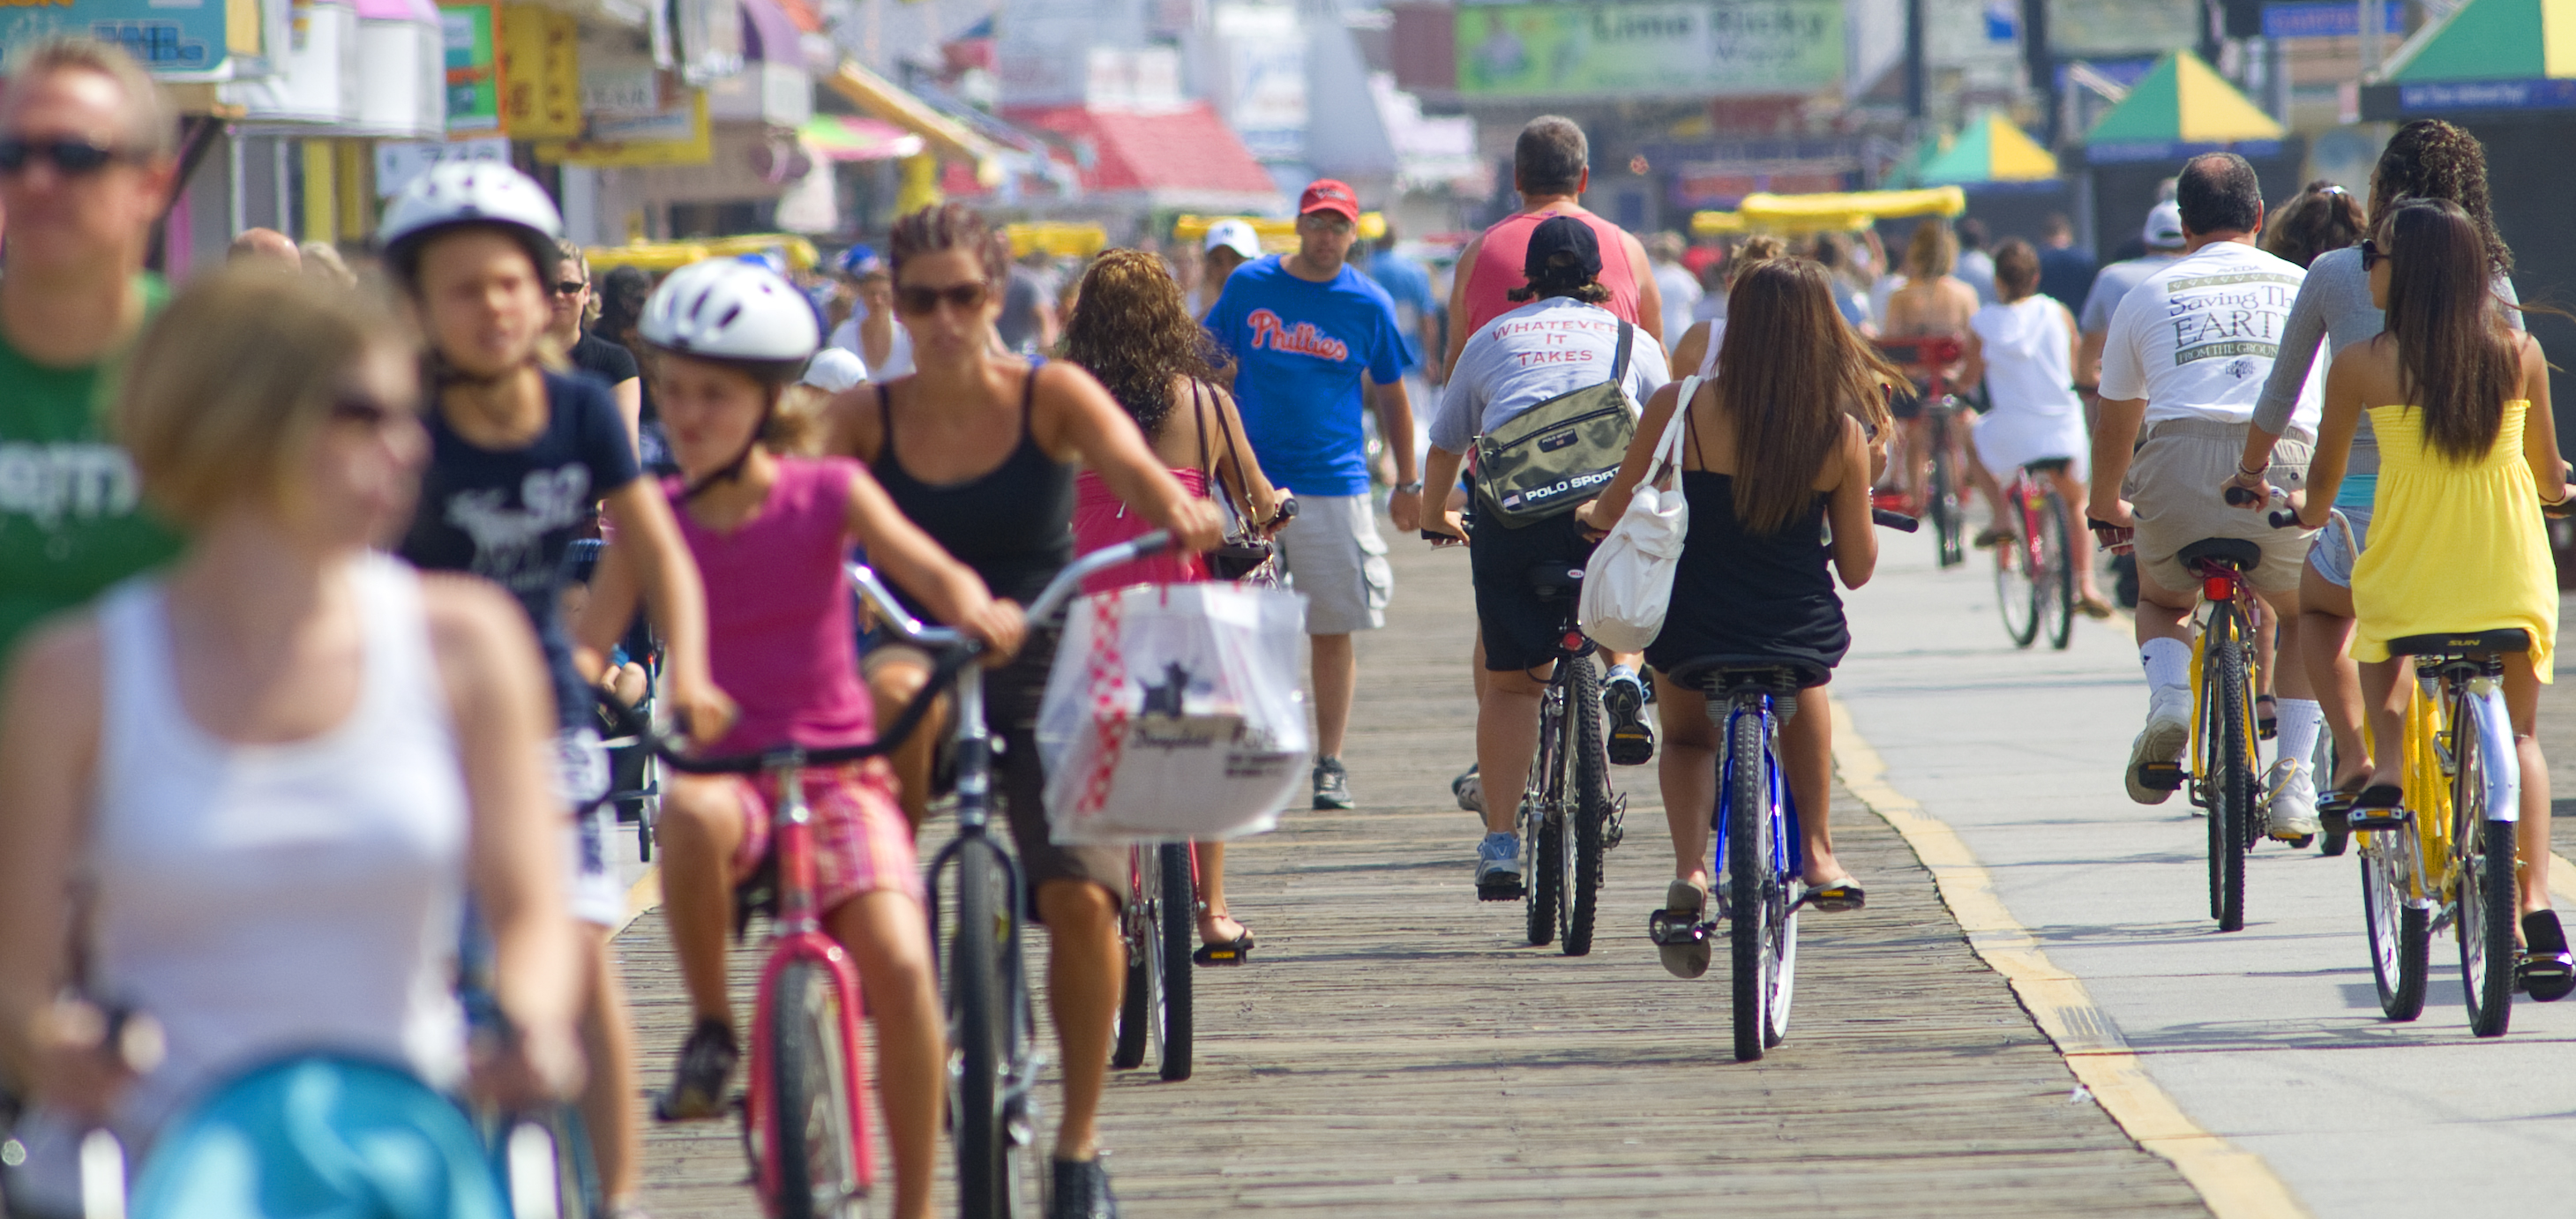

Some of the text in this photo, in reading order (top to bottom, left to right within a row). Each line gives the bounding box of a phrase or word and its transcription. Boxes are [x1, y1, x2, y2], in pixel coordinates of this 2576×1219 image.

[2170, 285, 2294, 317] Saving Th
[1247, 308, 1349, 362] Phillies
[1546, 333, 1567, 345] IT
[2172, 310, 2289, 349] EART
[1517, 350, 1592, 366] TAKES
[2179, 348, 2209, 363] FROM
[2237, 342, 2277, 356] GROUN
[1525, 481, 1569, 501] POLO
